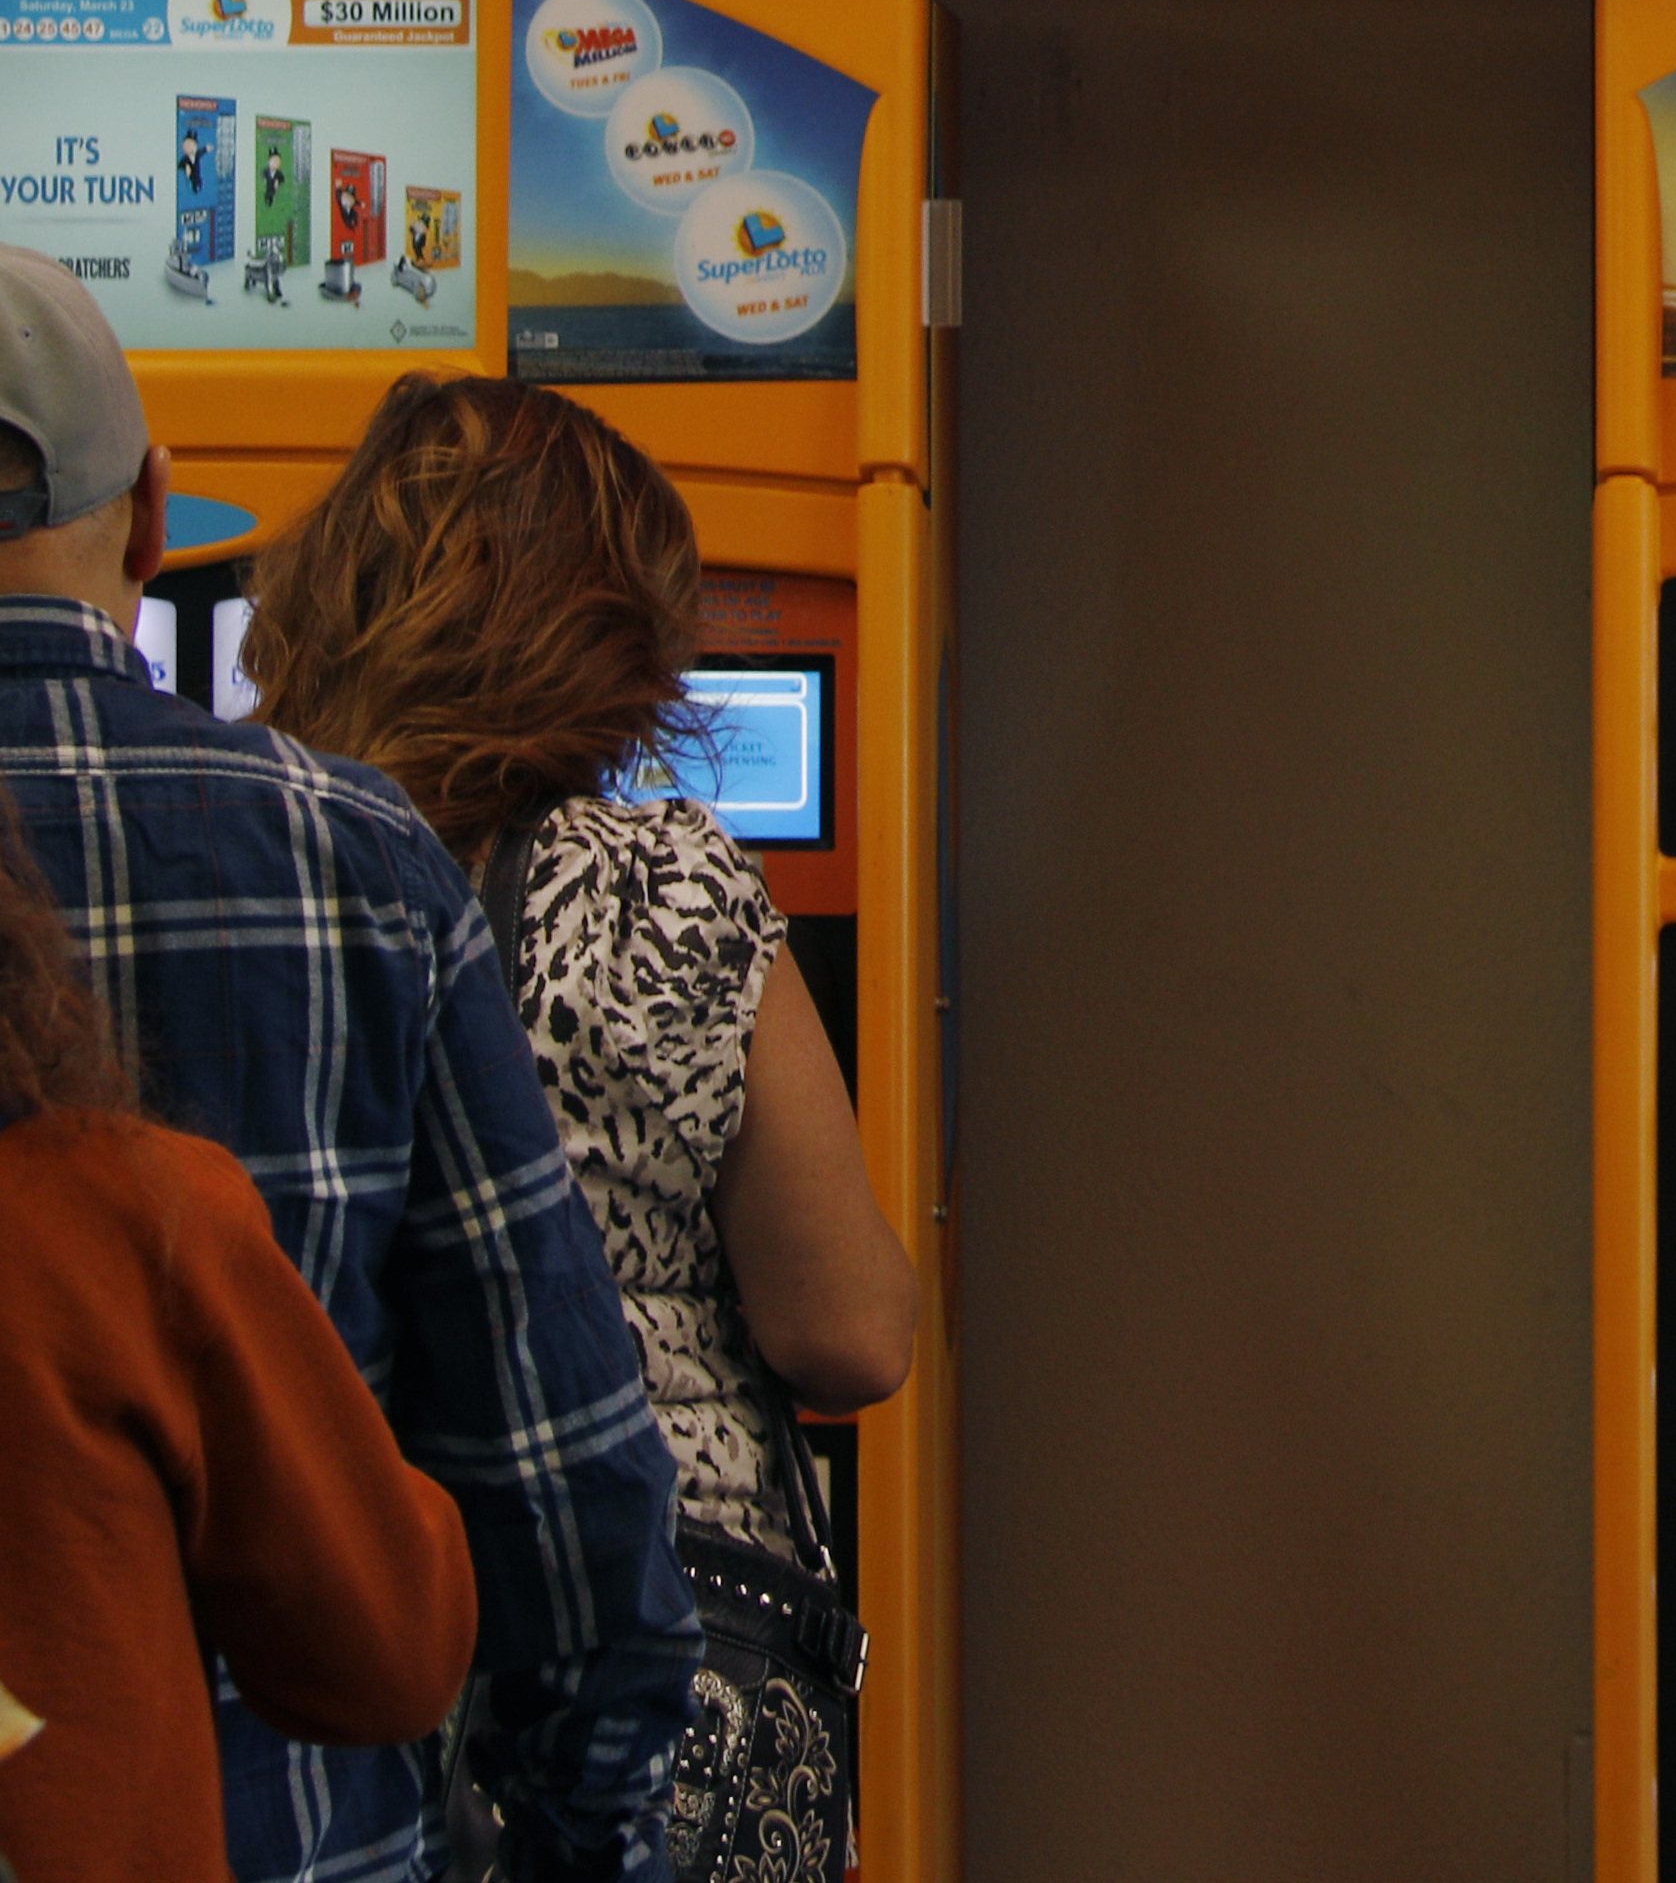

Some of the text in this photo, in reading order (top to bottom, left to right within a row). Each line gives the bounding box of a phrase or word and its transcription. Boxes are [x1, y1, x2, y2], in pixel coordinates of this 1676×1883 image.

[81, 0, 117, 11] March
[320, 0, 455, 24] $30 Million
[407, 30, 455, 44] Jackpot
[577, 27, 636, 55] MEGA
[56, 136, 100, 166] IT'S
[653, 167, 720, 185] WED SAT
[1, 175, 155, 205] YOUR TURN
[697, 248, 827, 284] SuperLotto
[737, 295, 809, 316] WED SAT
